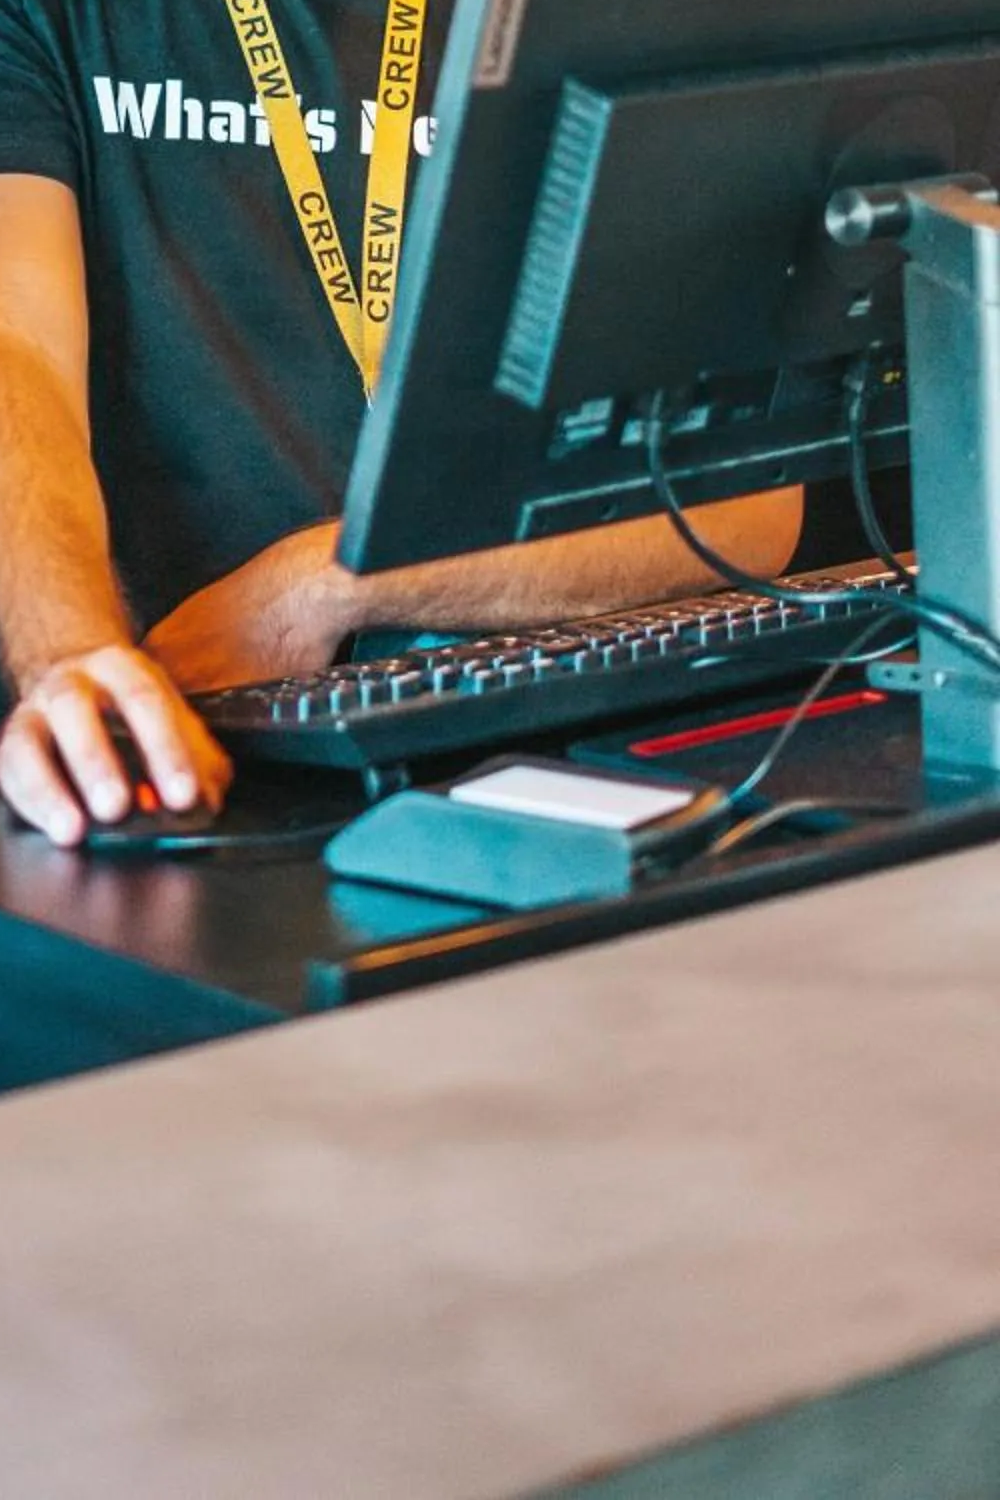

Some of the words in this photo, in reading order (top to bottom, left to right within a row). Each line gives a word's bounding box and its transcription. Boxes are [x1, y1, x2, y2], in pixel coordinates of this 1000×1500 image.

[382, 1, 419, 111] CREW
[299, 191, 355, 304] CREW
[366, 202, 398, 323] CREW
